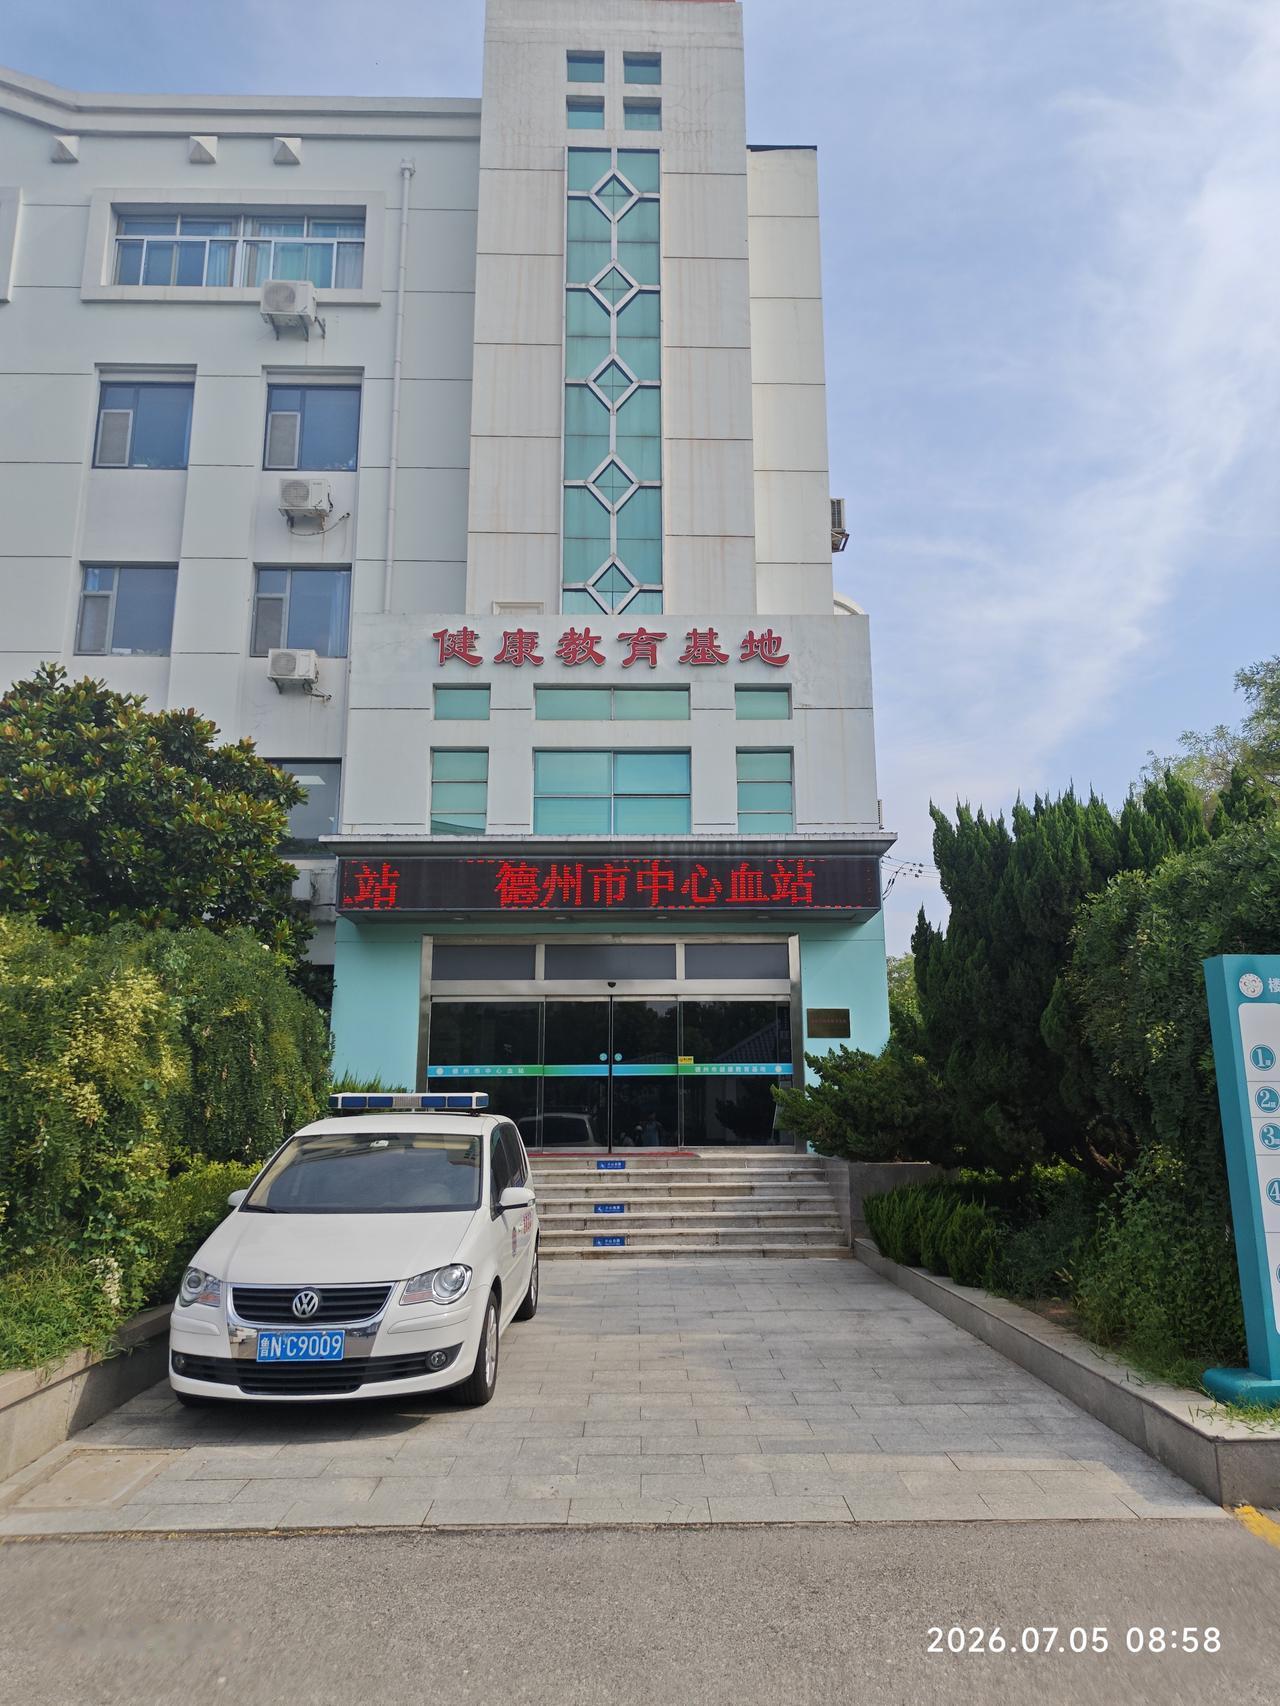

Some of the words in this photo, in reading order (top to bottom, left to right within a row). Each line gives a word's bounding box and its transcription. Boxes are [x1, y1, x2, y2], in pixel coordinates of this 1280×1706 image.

[432, 626, 791, 668] 健康教育基地
[344, 863, 400, 908] 站
[494, 861, 816, 907] 德州市中心血站
